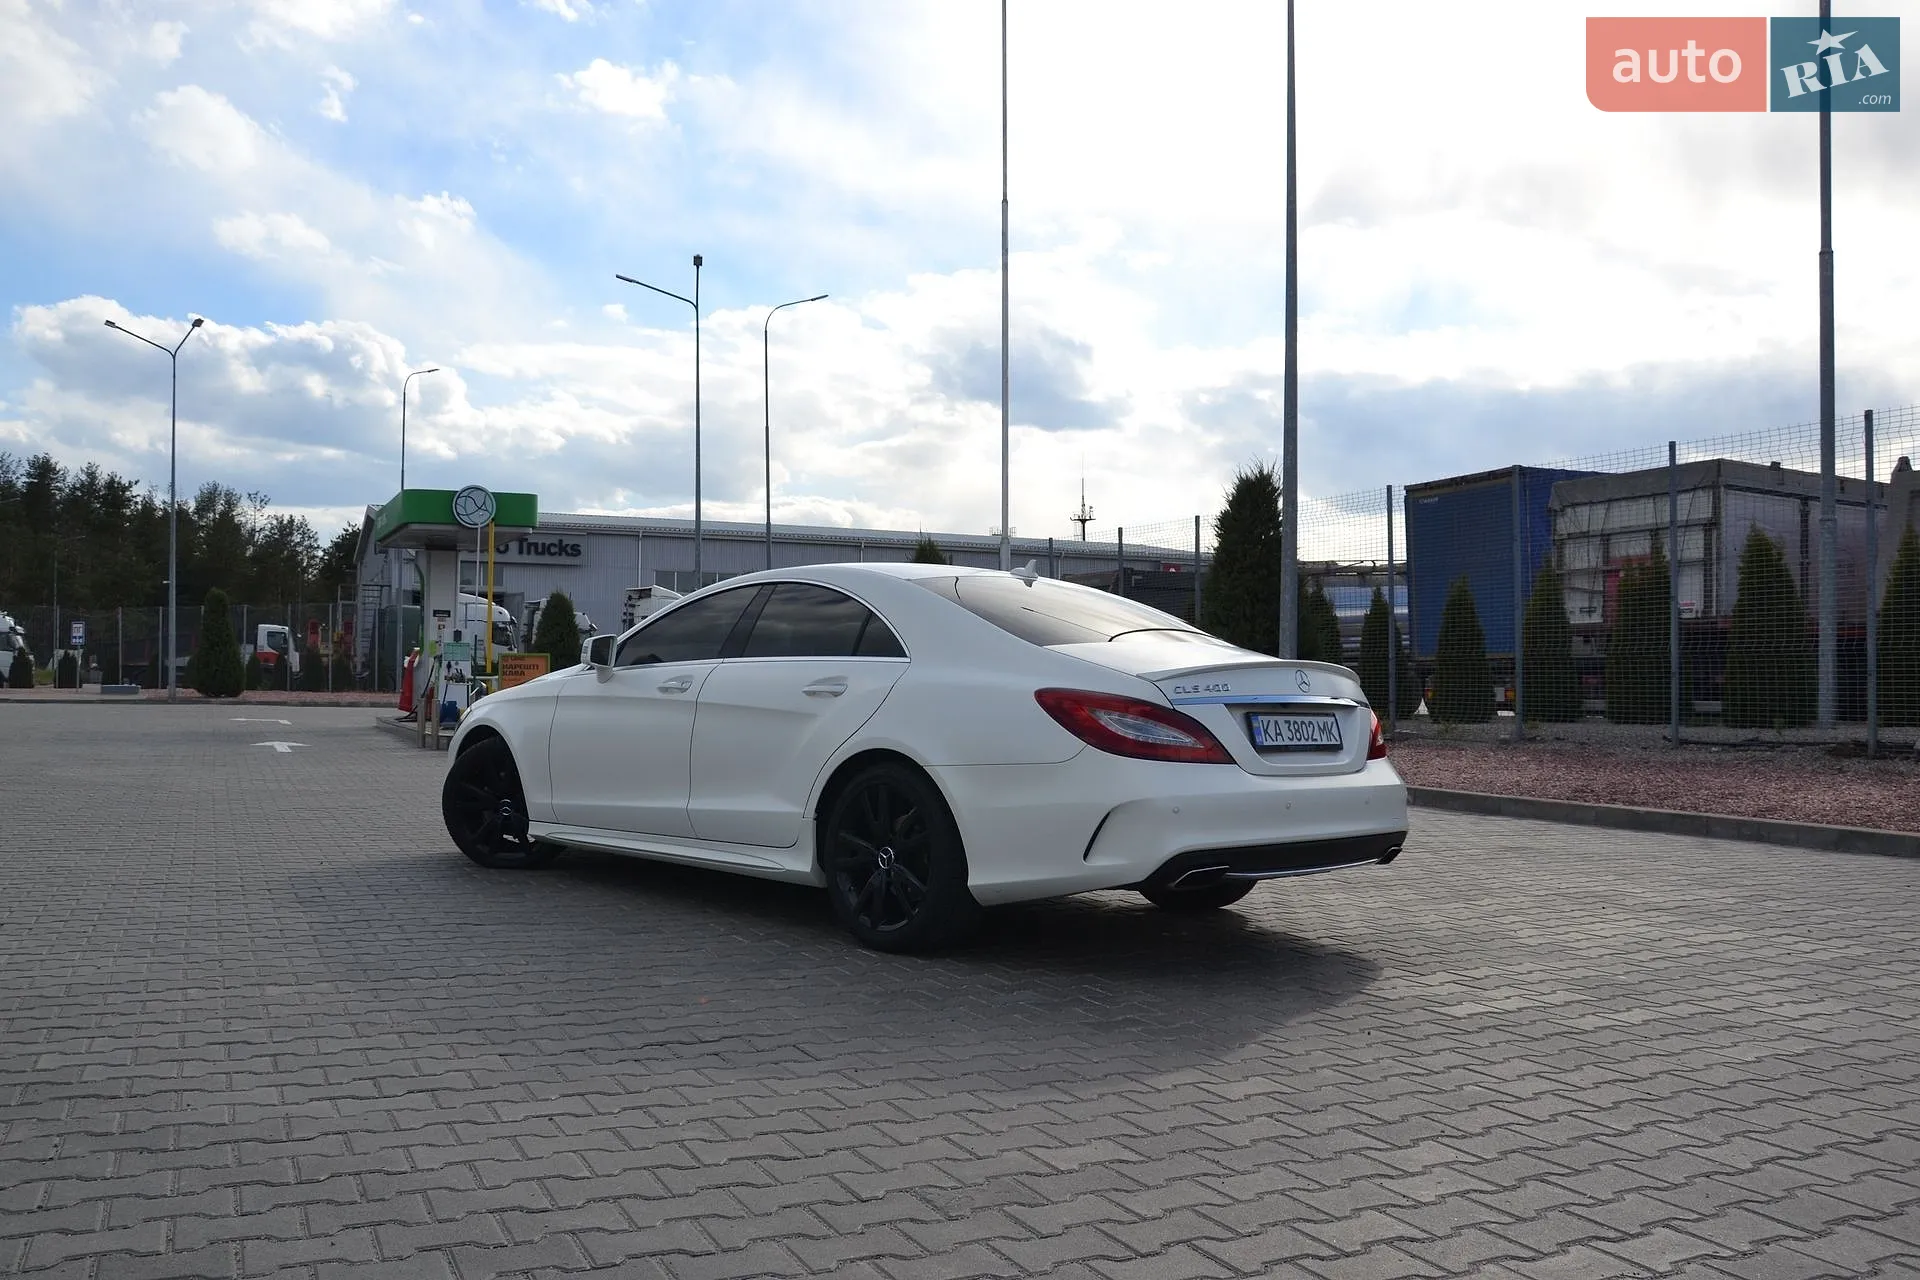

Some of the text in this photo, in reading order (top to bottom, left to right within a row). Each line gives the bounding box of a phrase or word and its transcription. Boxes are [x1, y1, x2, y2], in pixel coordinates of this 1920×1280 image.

[518, 538, 581, 557] Trucks
[1174, 683, 1231, 694] CLS 400
[1261, 719, 1338, 742] KA 3802 MK
